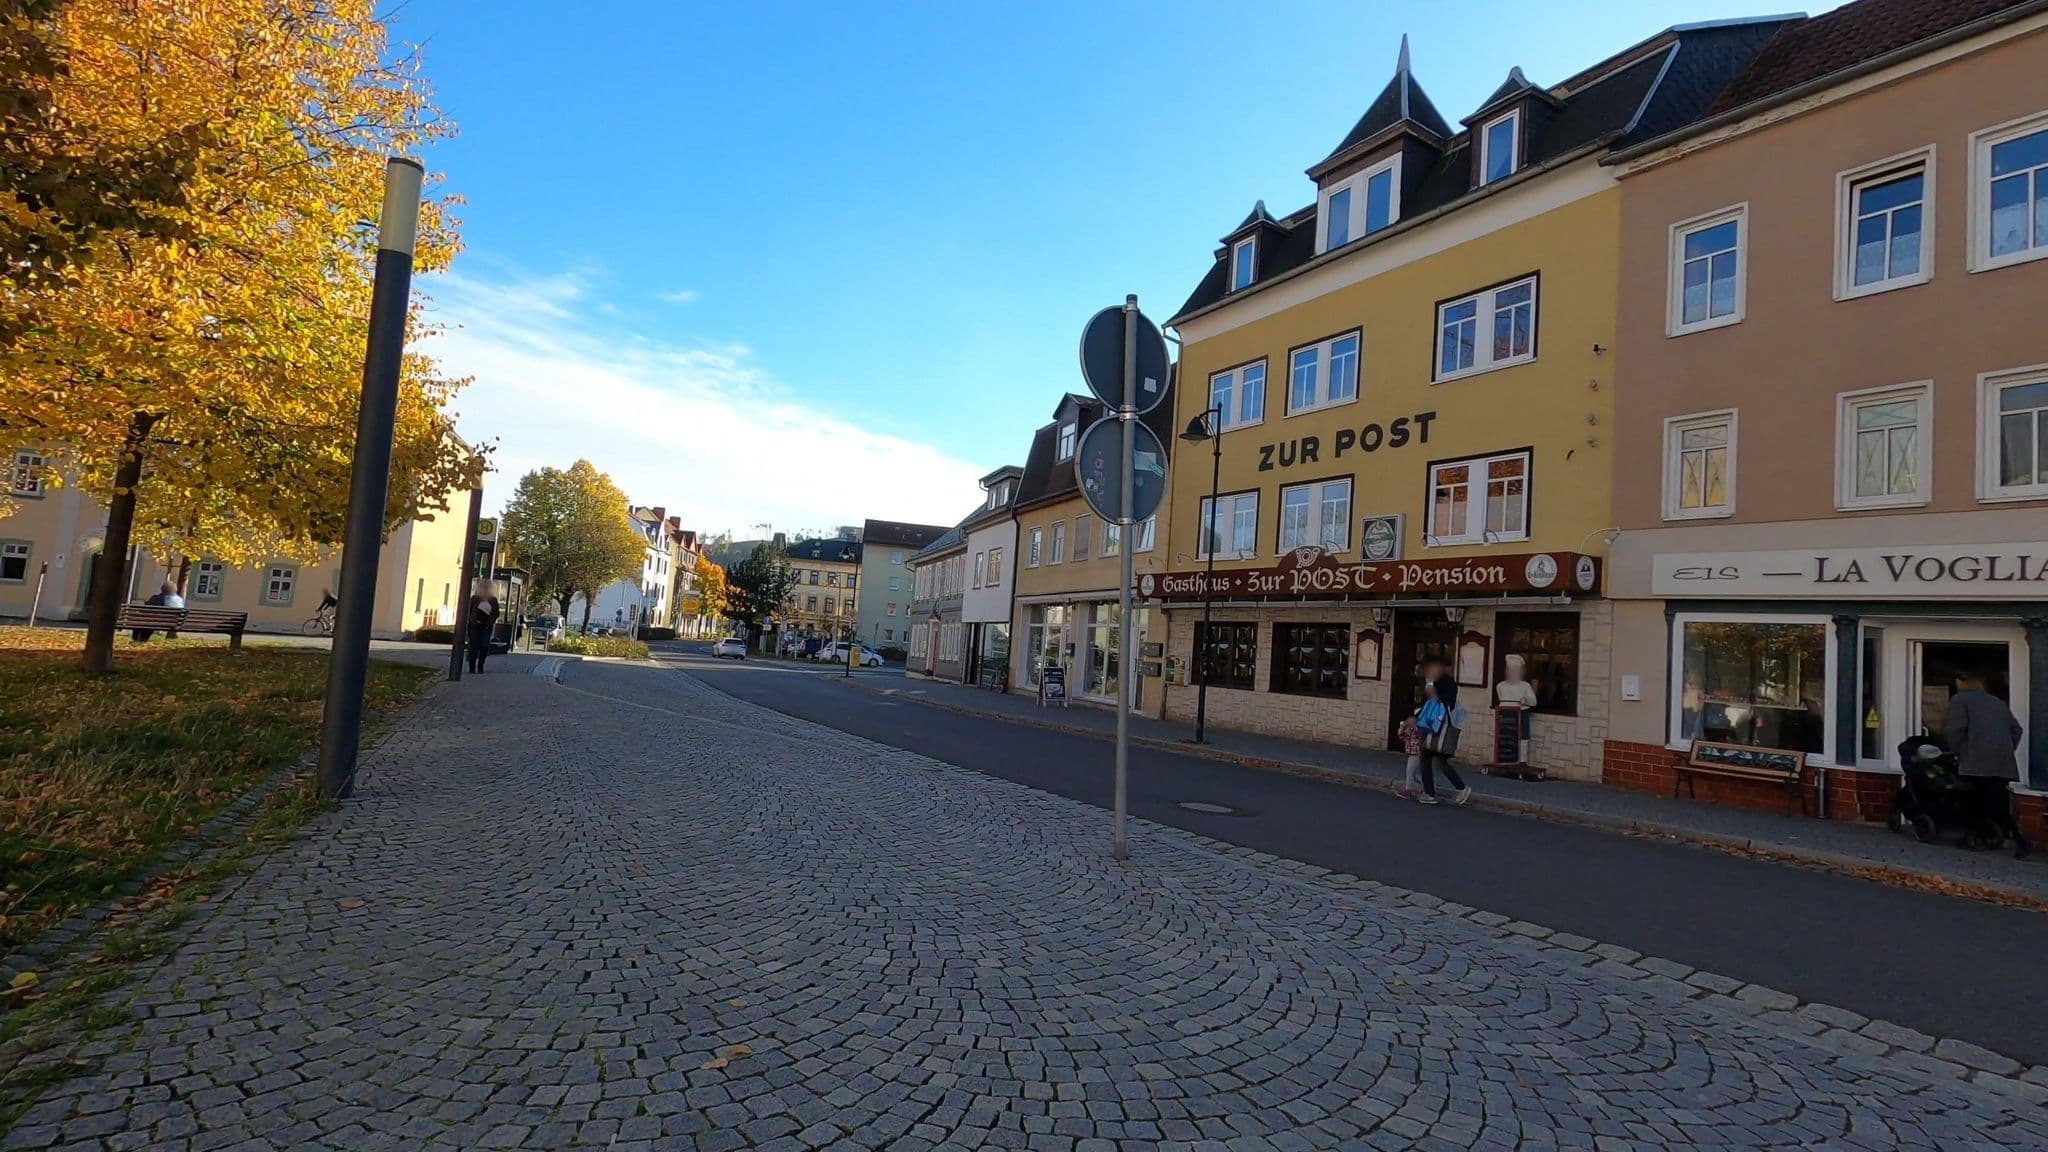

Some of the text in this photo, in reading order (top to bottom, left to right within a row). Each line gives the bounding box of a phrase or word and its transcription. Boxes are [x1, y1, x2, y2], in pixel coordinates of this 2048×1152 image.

[1258, 411, 1437, 472] ZUR POST
[1247, 571, 1285, 592] Zur
[1289, 566, 1378, 594] POST
[1398, 559, 1507, 592] Pension
[1672, 566, 1740, 581] EIS
[1813, 557, 1869, 583] LA
